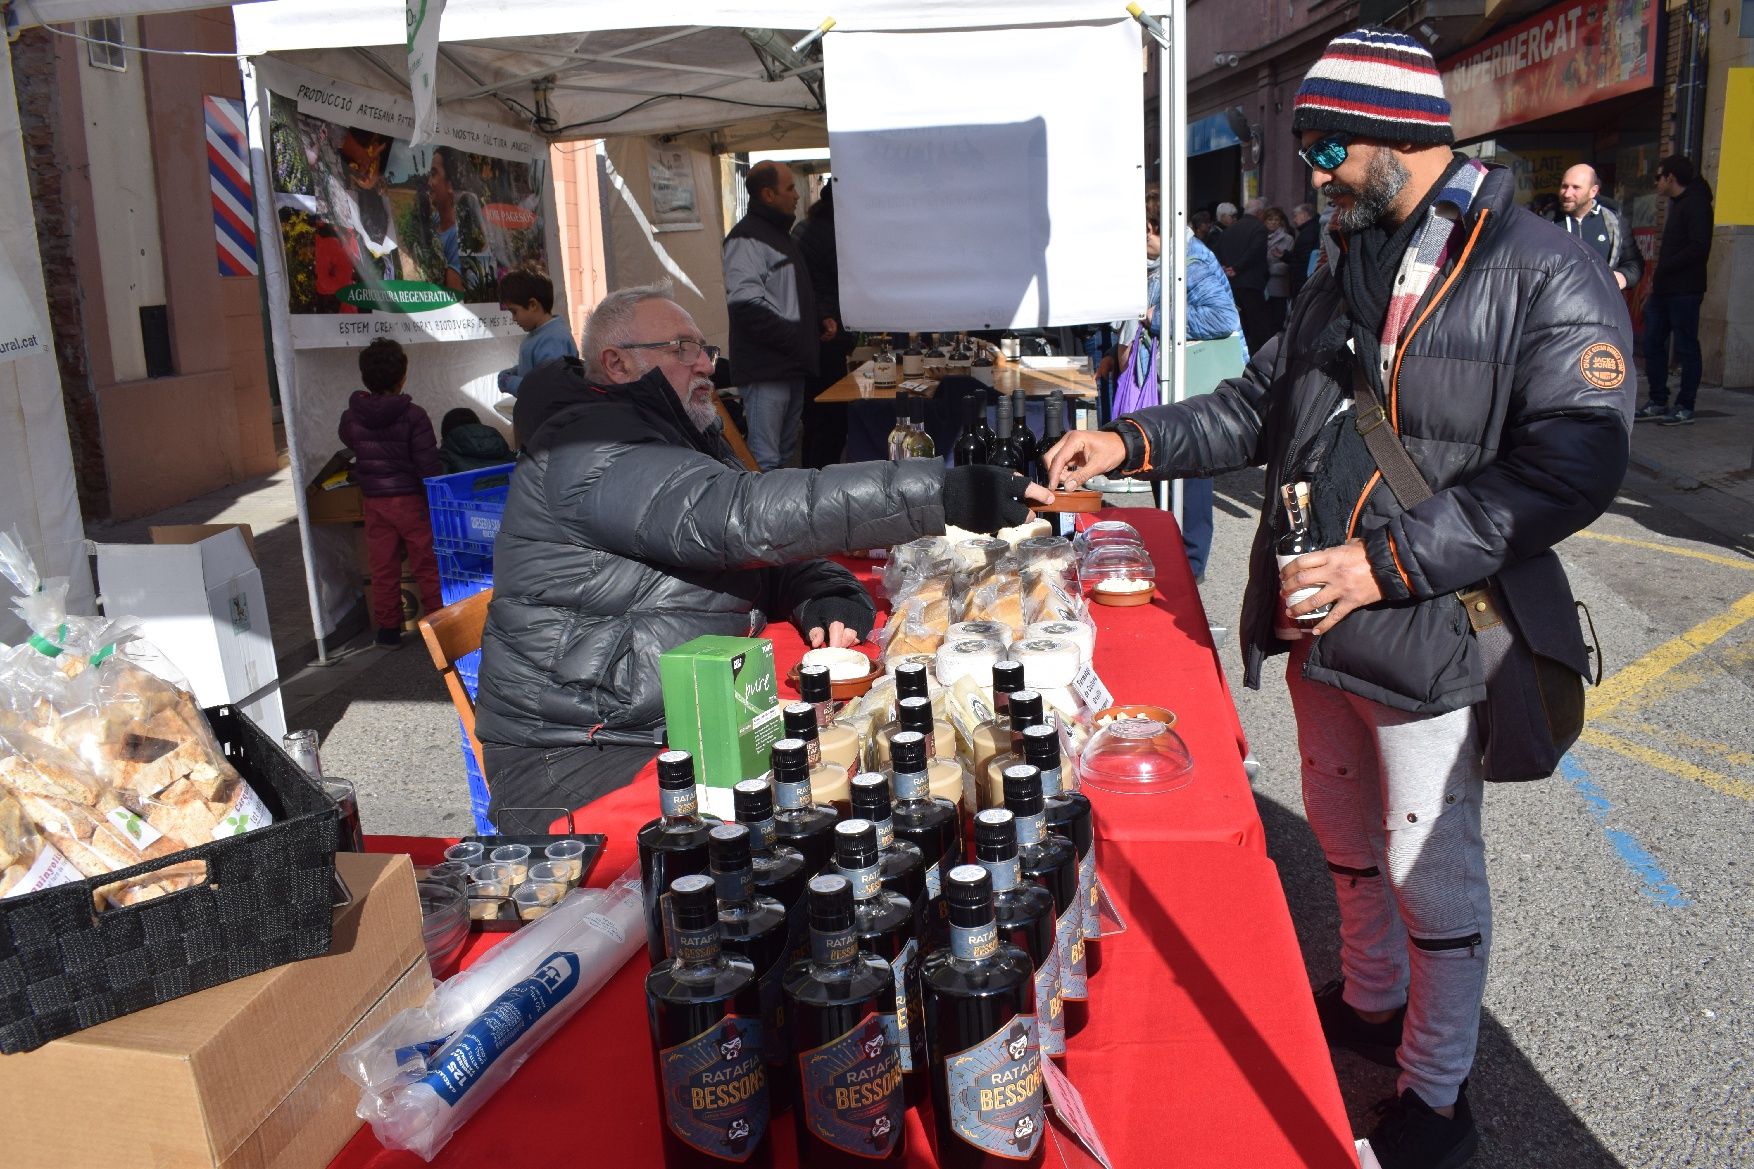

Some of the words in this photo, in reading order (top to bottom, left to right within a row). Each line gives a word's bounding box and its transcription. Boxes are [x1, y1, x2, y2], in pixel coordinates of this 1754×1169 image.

[1452, 6, 1582, 95] SUPERMERCAT
[297, 84, 353, 112] PRODUCCIÓ
[452, 127, 480, 143] NOSTRA
[399, 290, 457, 303] REGENERATIVA
[339, 321, 369, 334] ESTEM
[745, 673, 770, 705] pure
[446, 1061, 467, 1087] 125
[702, 1053, 761, 1084] RATAFIA
[847, 1049, 900, 1084] RATAFIA
